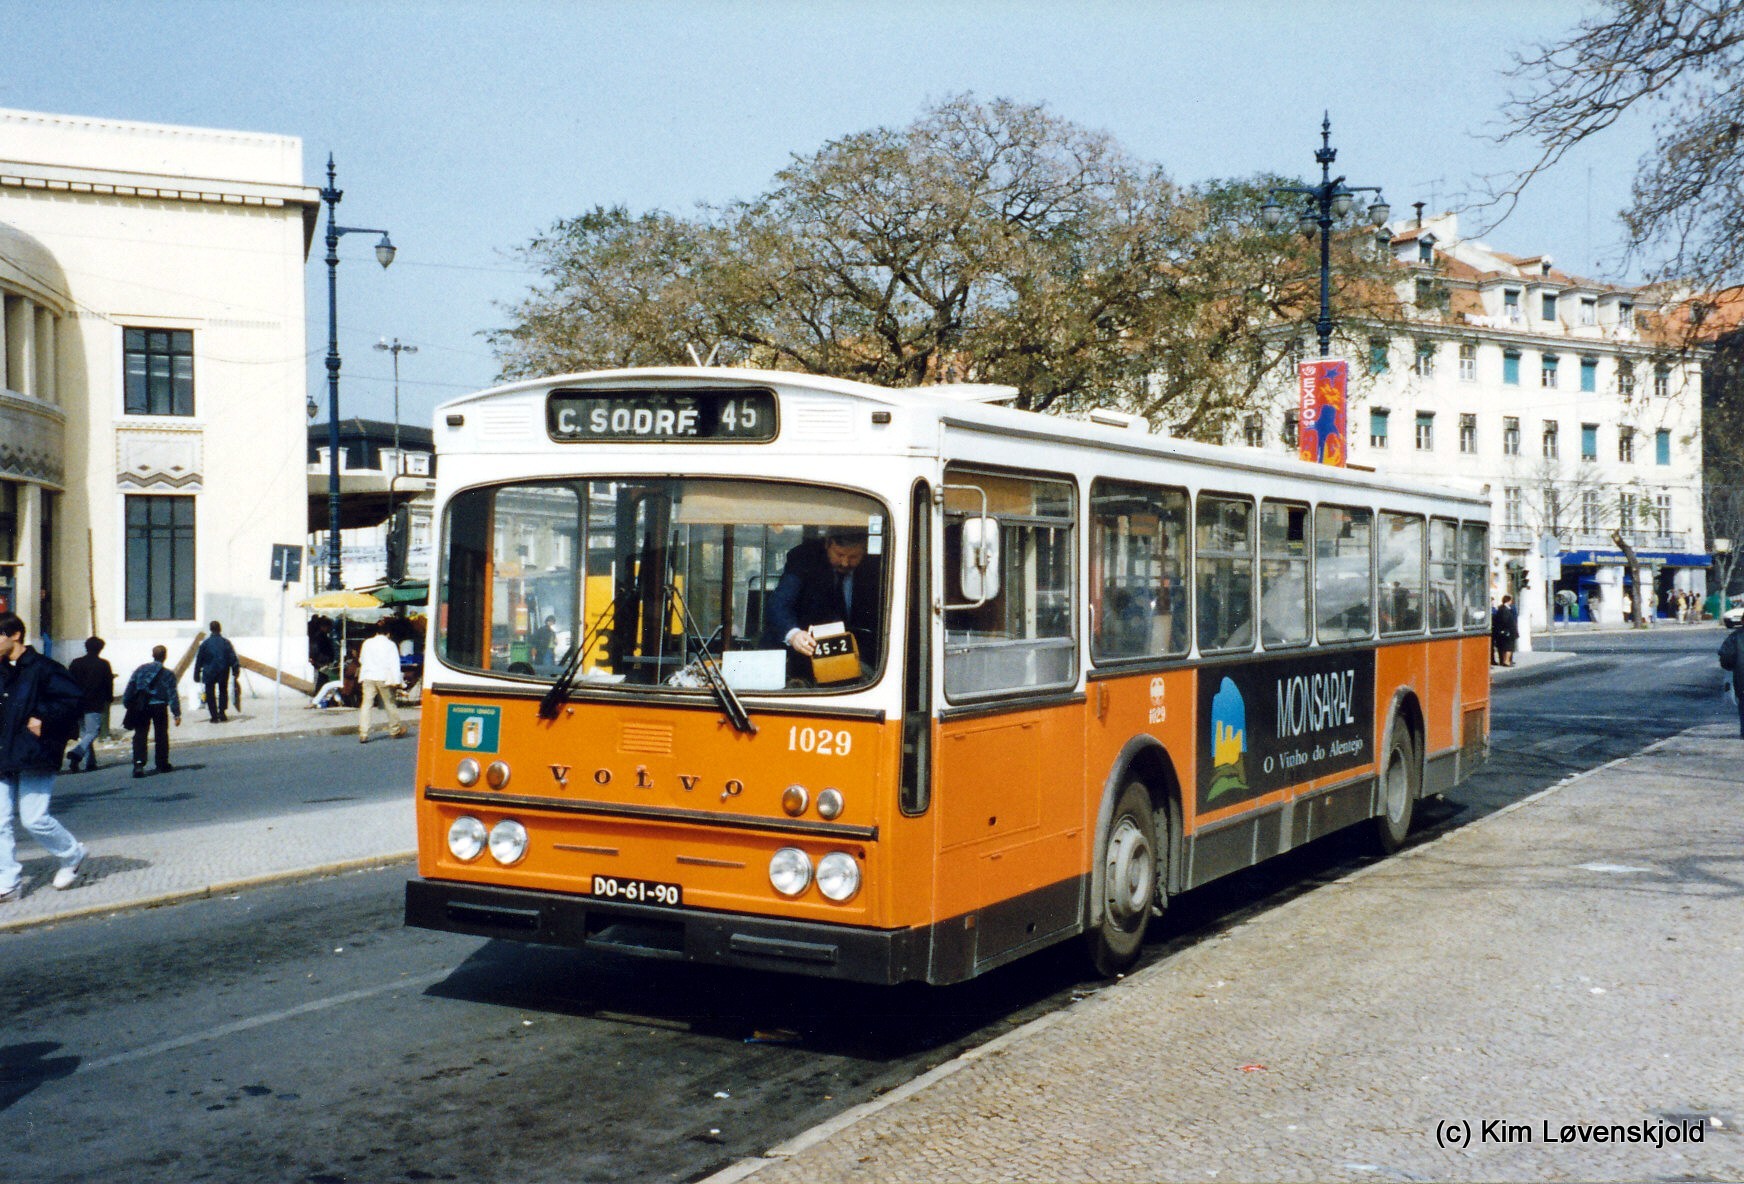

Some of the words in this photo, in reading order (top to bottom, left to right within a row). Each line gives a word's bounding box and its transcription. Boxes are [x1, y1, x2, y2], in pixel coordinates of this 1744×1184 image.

[1303, 378, 1316, 420] EXPO
[558, 408, 582, 433] C.
[722, 399, 757, 431] 45
[815, 639, 848, 656] 45-2
[1277, 669, 1355, 739] MONSARAZ
[788, 725, 852, 756] 1029
[1263, 756, 1274, 774] O
[1279, 749, 1308, 769] Vinho
[1312, 745, 1326, 762] do
[1329, 735, 1364, 757] Alentejo
[549, 764, 744, 797] VOLVO
[594, 876, 679, 905] DO-61-90
